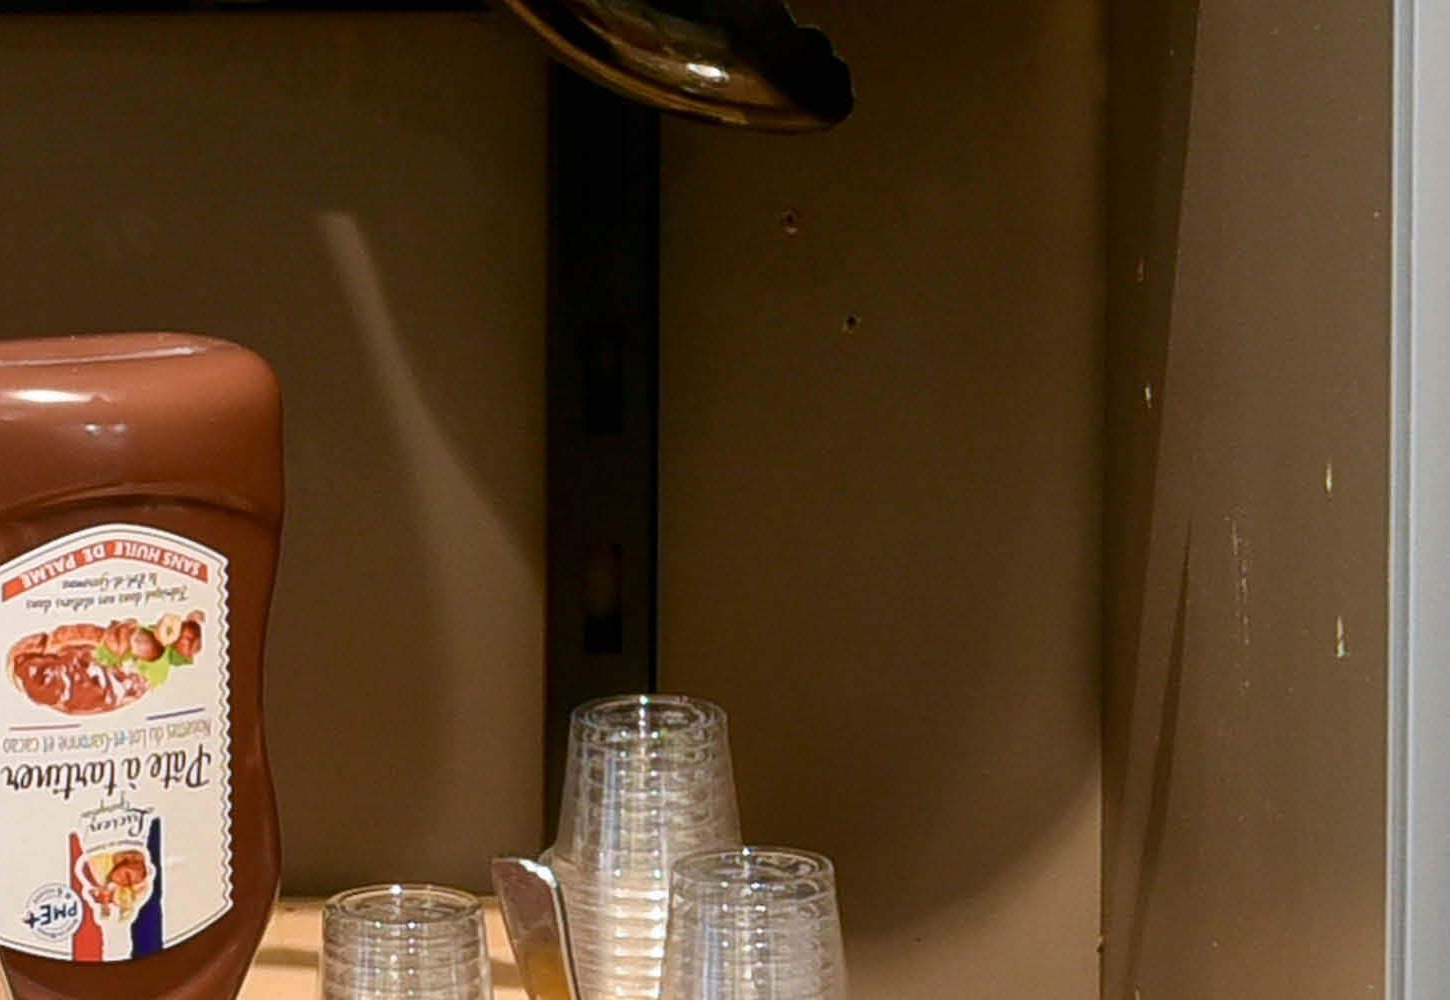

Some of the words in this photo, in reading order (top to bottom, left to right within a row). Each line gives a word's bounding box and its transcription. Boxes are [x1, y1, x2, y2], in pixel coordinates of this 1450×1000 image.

[82, 543, 106, 562] DE
[115, 540, 163, 562] HUILE
[163, 549, 201, 578] SANS
[21, 549, 79, 588] PALME
[0, 760, 117, 800] tartiner
[121, 757, 141, 791] à
[150, 743, 212, 790] Pâte
